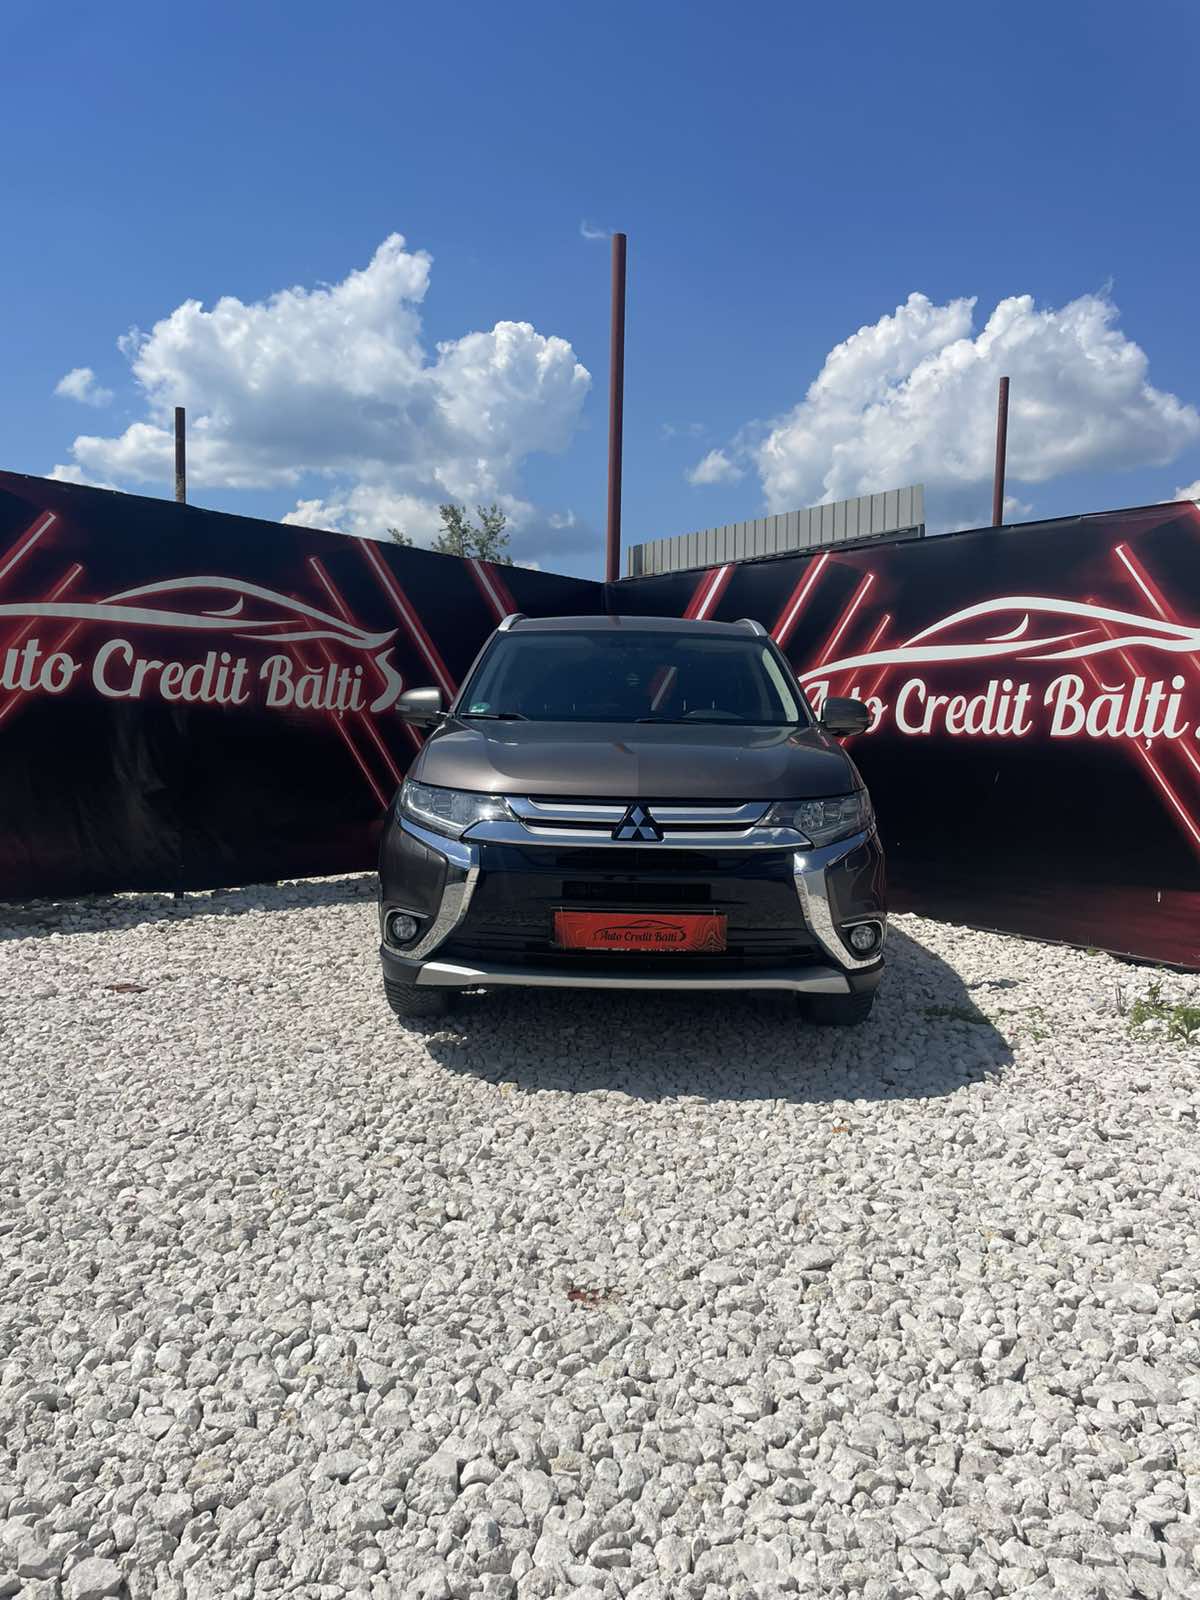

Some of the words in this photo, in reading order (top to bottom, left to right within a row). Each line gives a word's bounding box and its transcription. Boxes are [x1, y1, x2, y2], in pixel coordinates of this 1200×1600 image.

[92, 638, 250, 705] Credit
[259, 654, 367, 720] Bălți
[896, 678, 1033, 736] Credit
[1044, 673, 1190, 751] Bălți
